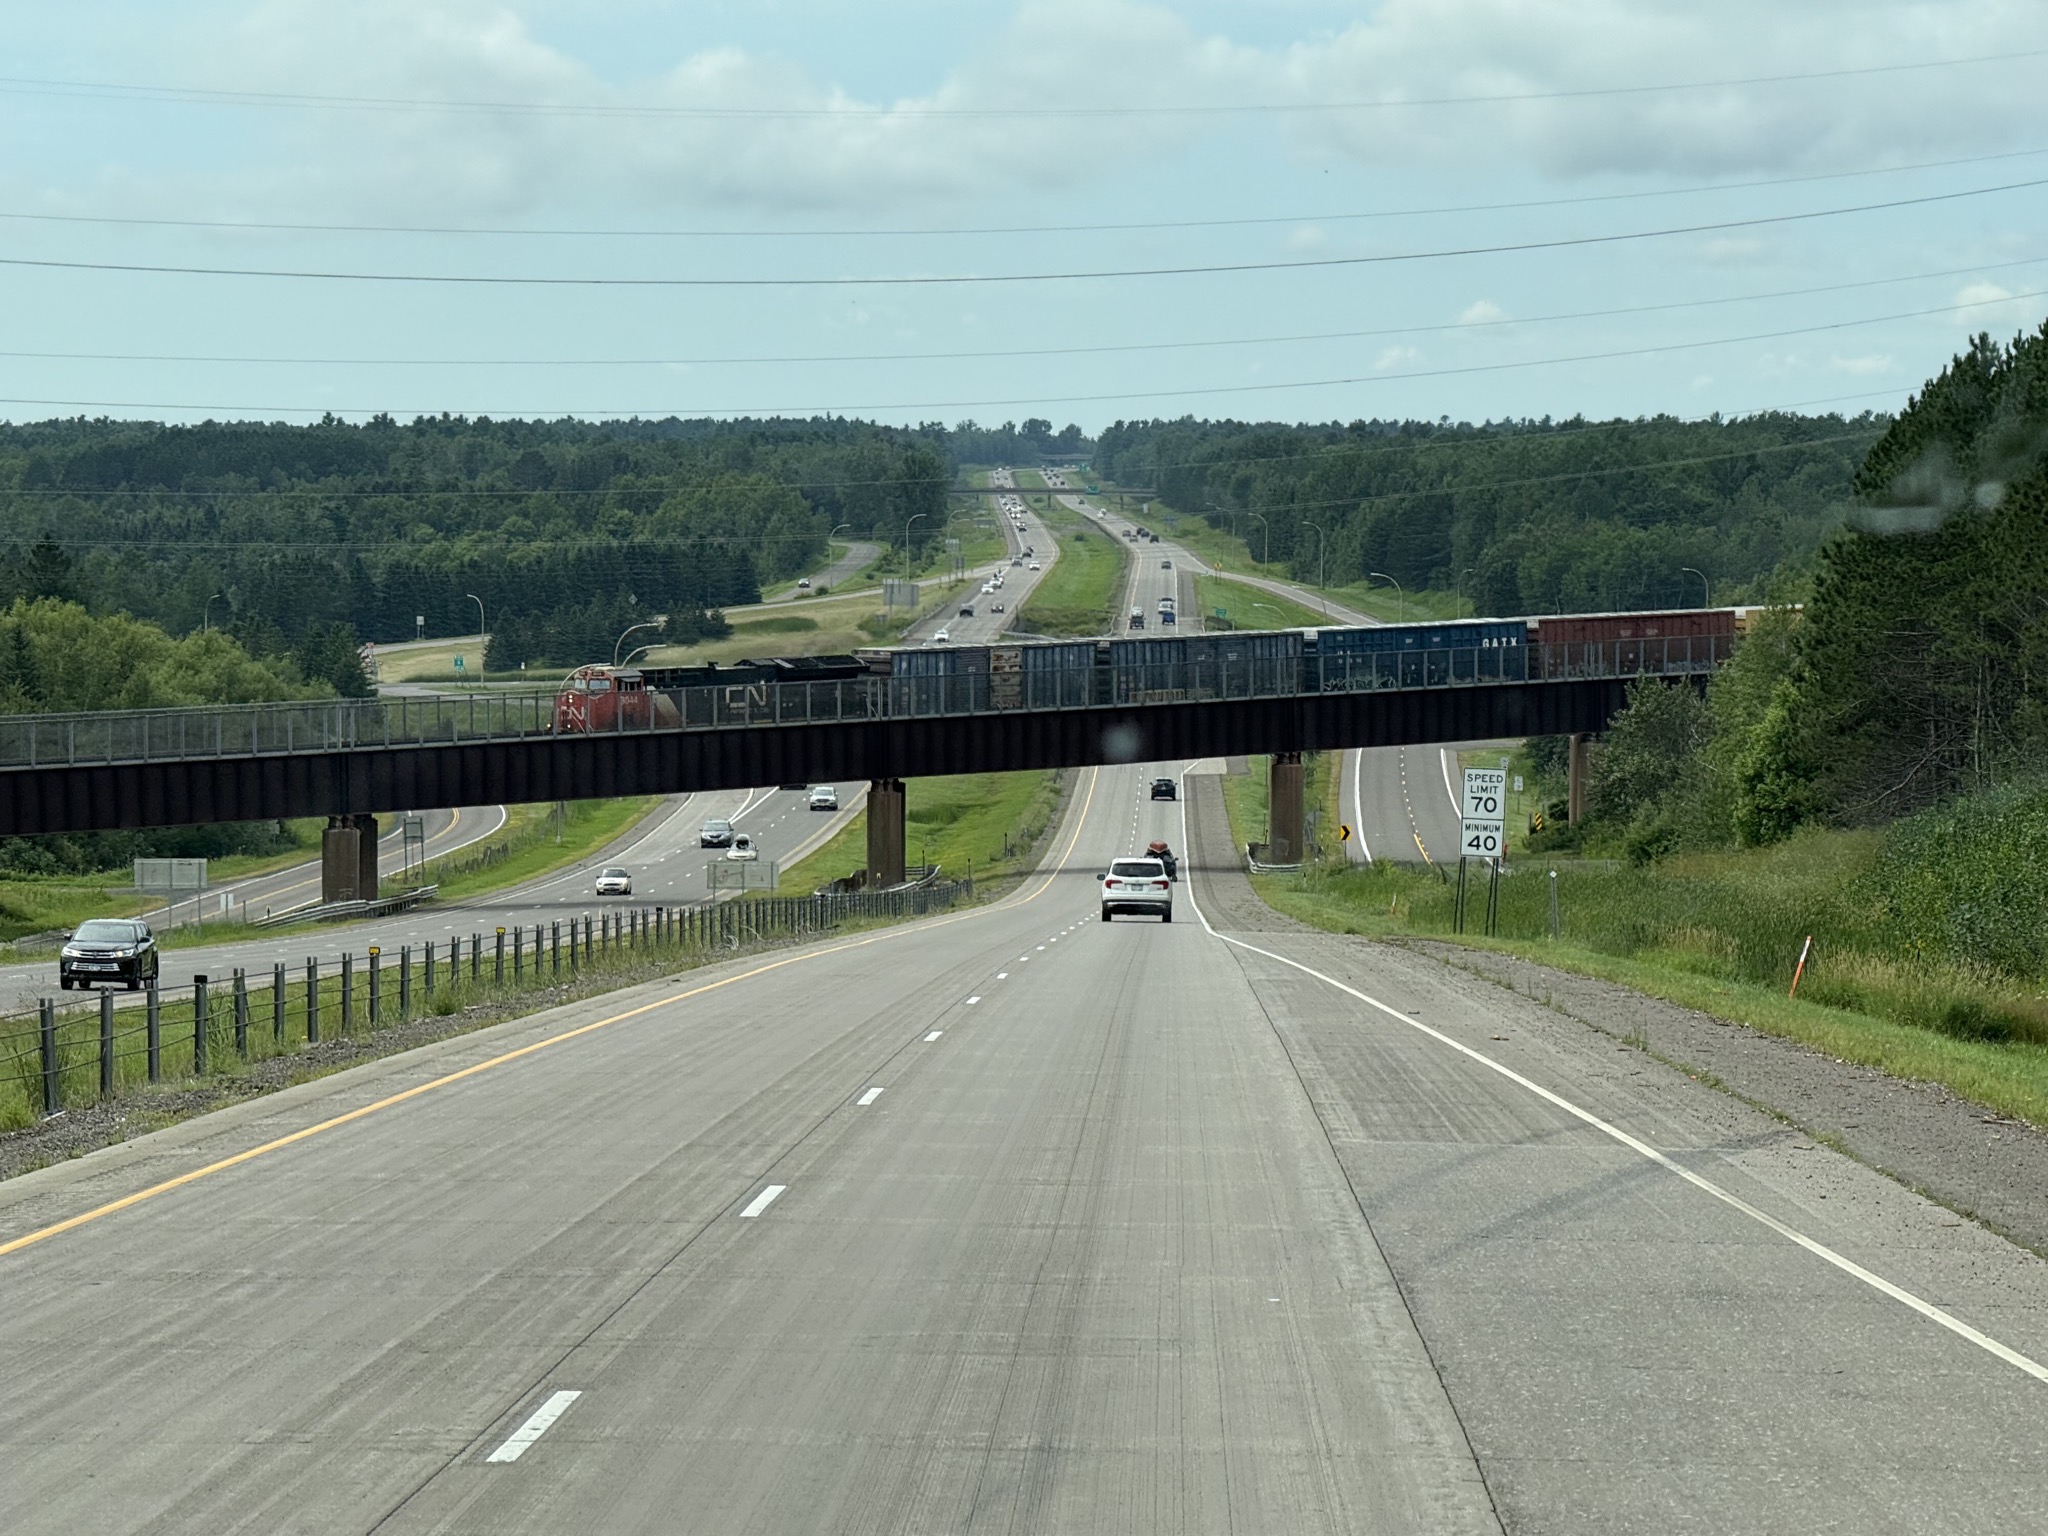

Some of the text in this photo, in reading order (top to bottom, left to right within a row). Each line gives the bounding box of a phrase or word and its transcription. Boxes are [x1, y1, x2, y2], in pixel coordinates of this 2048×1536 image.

[1482, 637, 1517, 648] GATX
[726, 685, 767, 708] CN
[1467, 774, 1503, 783] SPEED
[1470, 785, 1499, 794] LIMIT
[1471, 797, 1497, 813] 70
[1465, 823, 1501, 833] MINIMUM
[1467, 835, 1497, 851] 40
